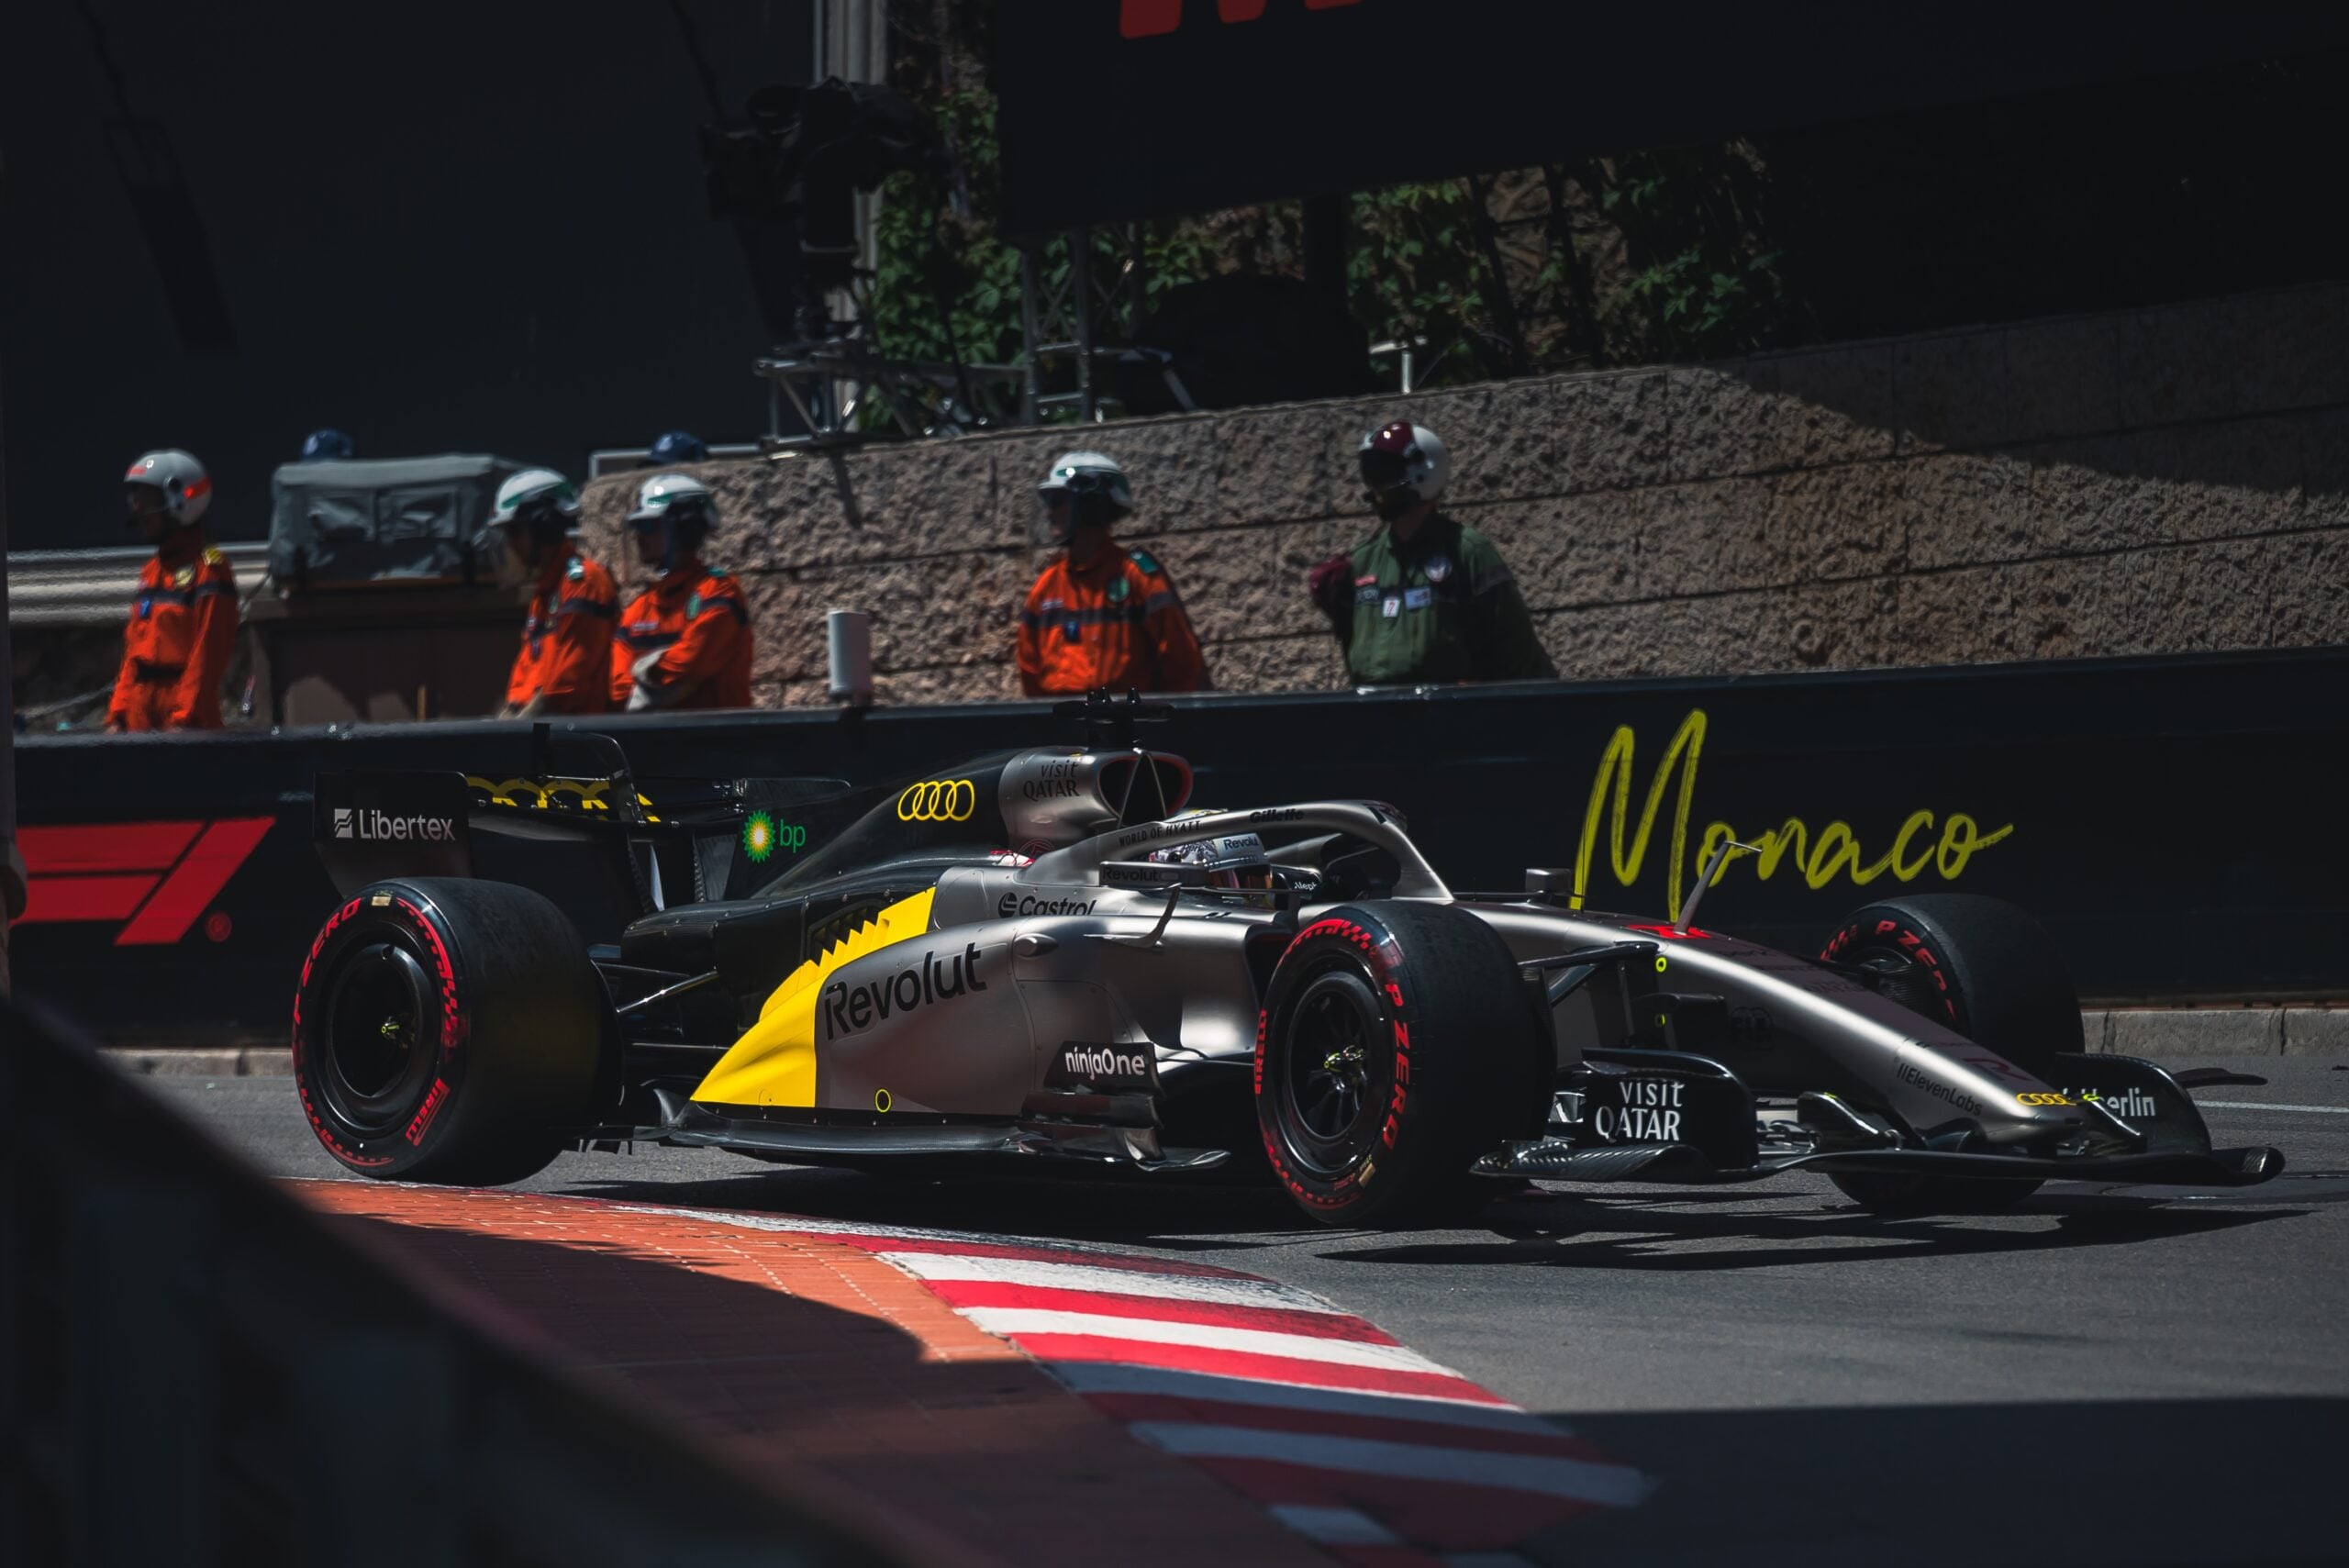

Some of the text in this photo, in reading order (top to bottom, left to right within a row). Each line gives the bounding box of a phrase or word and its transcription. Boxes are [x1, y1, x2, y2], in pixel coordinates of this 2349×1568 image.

[1041, 760, 1080, 778] visit
[1023, 779, 1080, 802] QATAR
[359, 808, 456, 841] Libertex
[1568, 707, 2013, 923] Monaco
[779, 818, 807, 854] bp
[1119, 820, 1202, 847] WORLD OF HYATT
[1223, 835, 1260, 851] Revolu
[1102, 866, 1158, 882] Revolut
[1019, 895, 1097, 917] Castrol
[825, 942, 987, 1050] Revolut
[1064, 1046, 1146, 1081] ninjaOne
[1382, 983, 1410, 1150] P ZERO
[1595, 1106, 1682, 1143] QATAR
